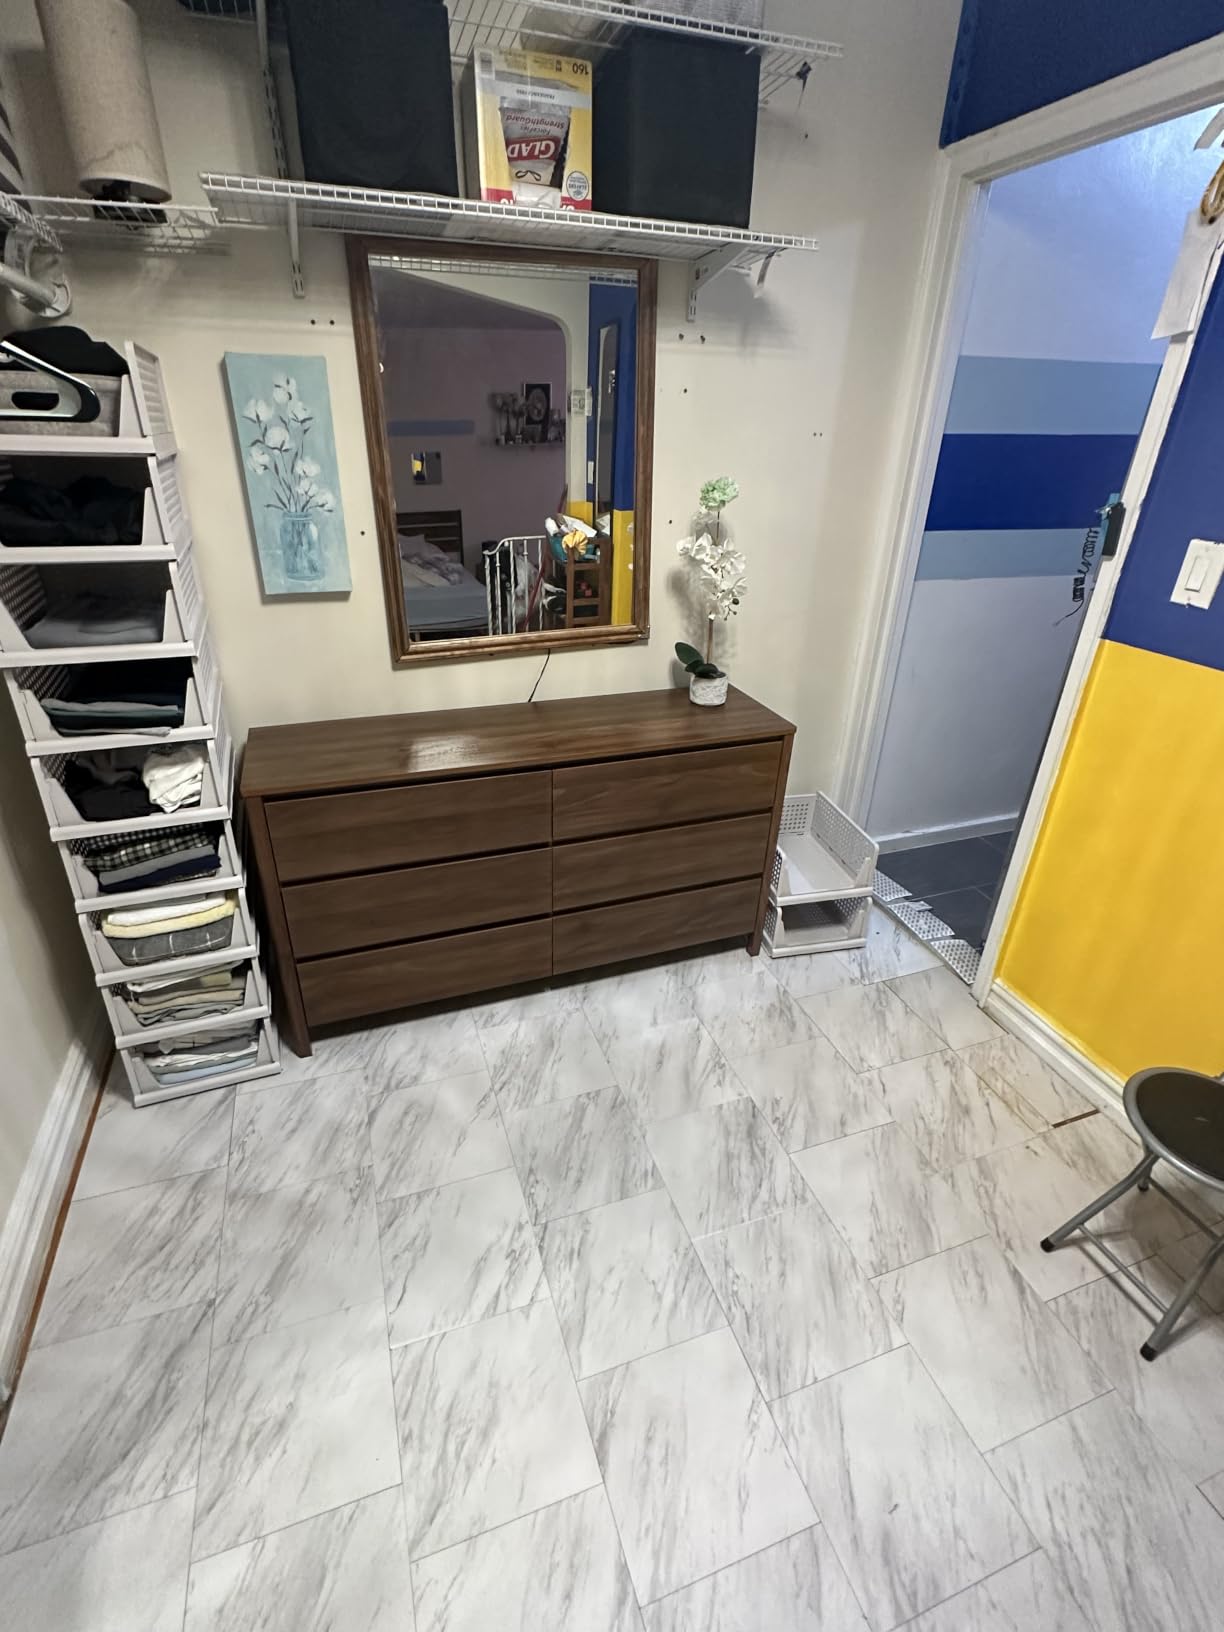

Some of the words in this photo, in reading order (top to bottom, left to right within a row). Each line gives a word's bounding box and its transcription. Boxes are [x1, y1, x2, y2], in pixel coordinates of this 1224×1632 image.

[572, 63, 589, 75] 160
[506, 114, 565, 129] StrengthGuard
[508, 141, 556, 159] GLAD
